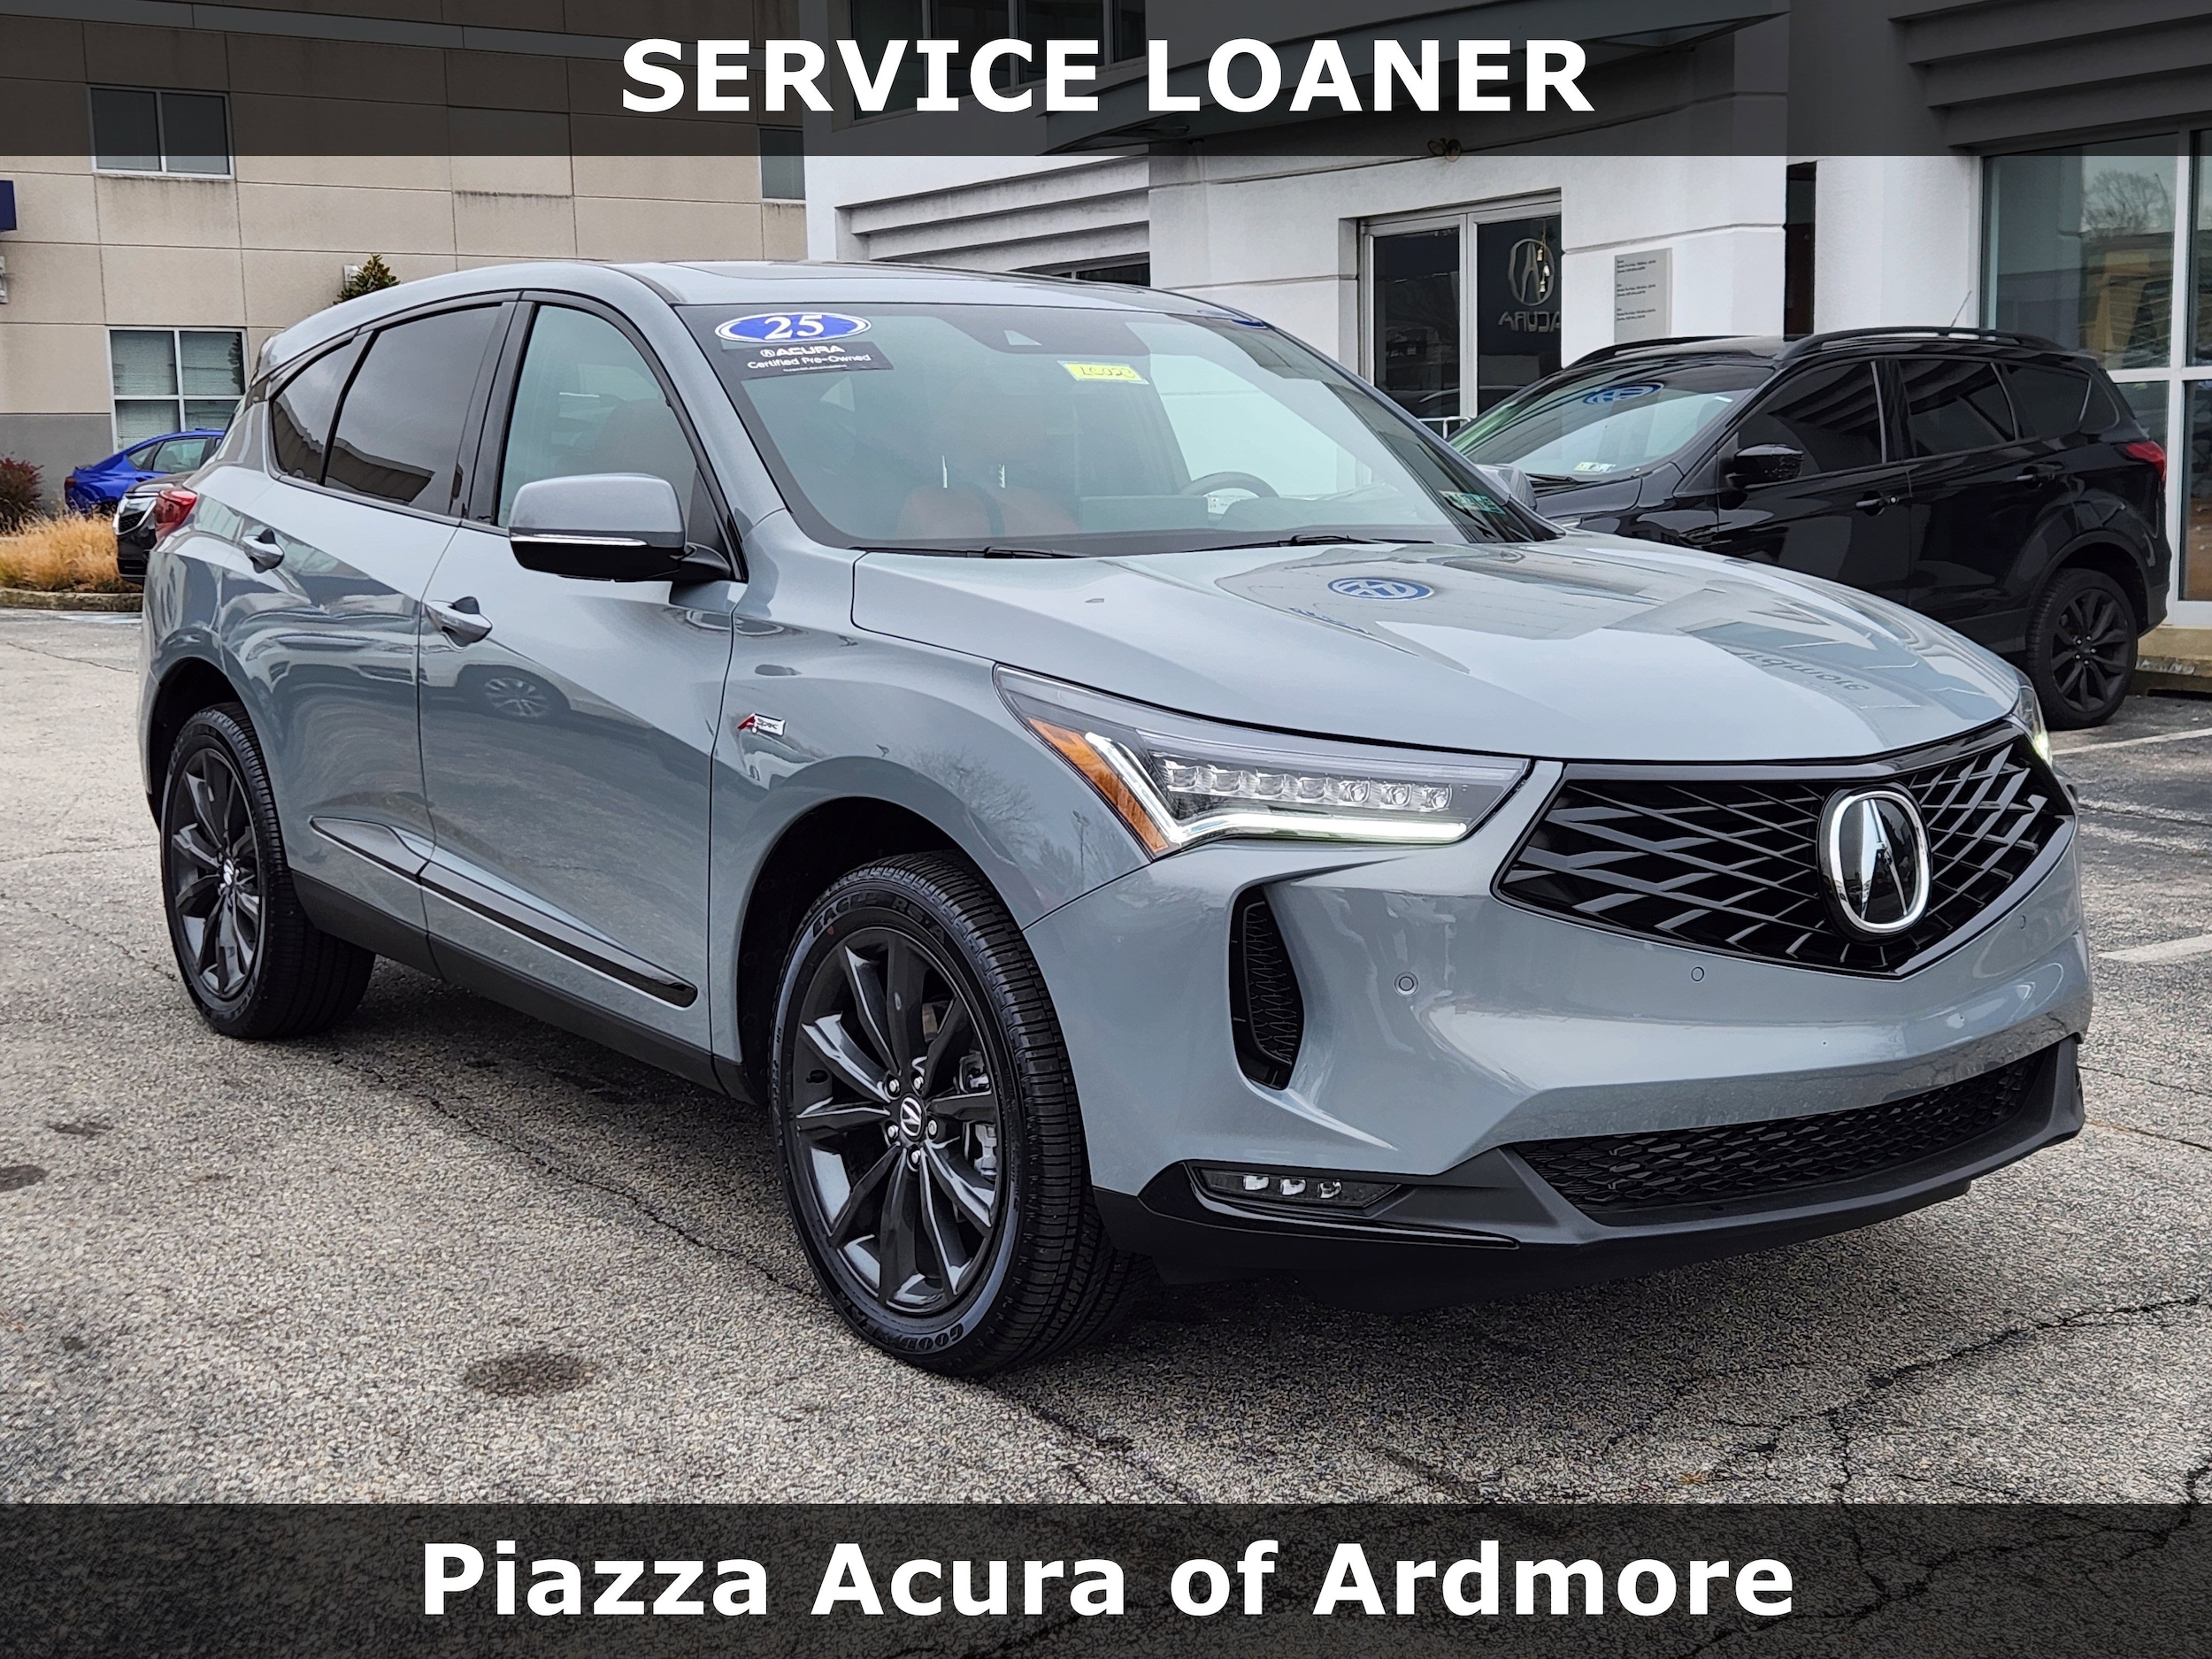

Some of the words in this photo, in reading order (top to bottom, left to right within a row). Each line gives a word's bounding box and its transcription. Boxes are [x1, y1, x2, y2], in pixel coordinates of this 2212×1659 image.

[764, 314, 823, 340] 25
[776, 344, 846, 357] ACURA
[747, 357, 800, 369] Certified
[801, 354, 872, 365] Pre-Owned
[812, 890, 879, 938] EAGLE
